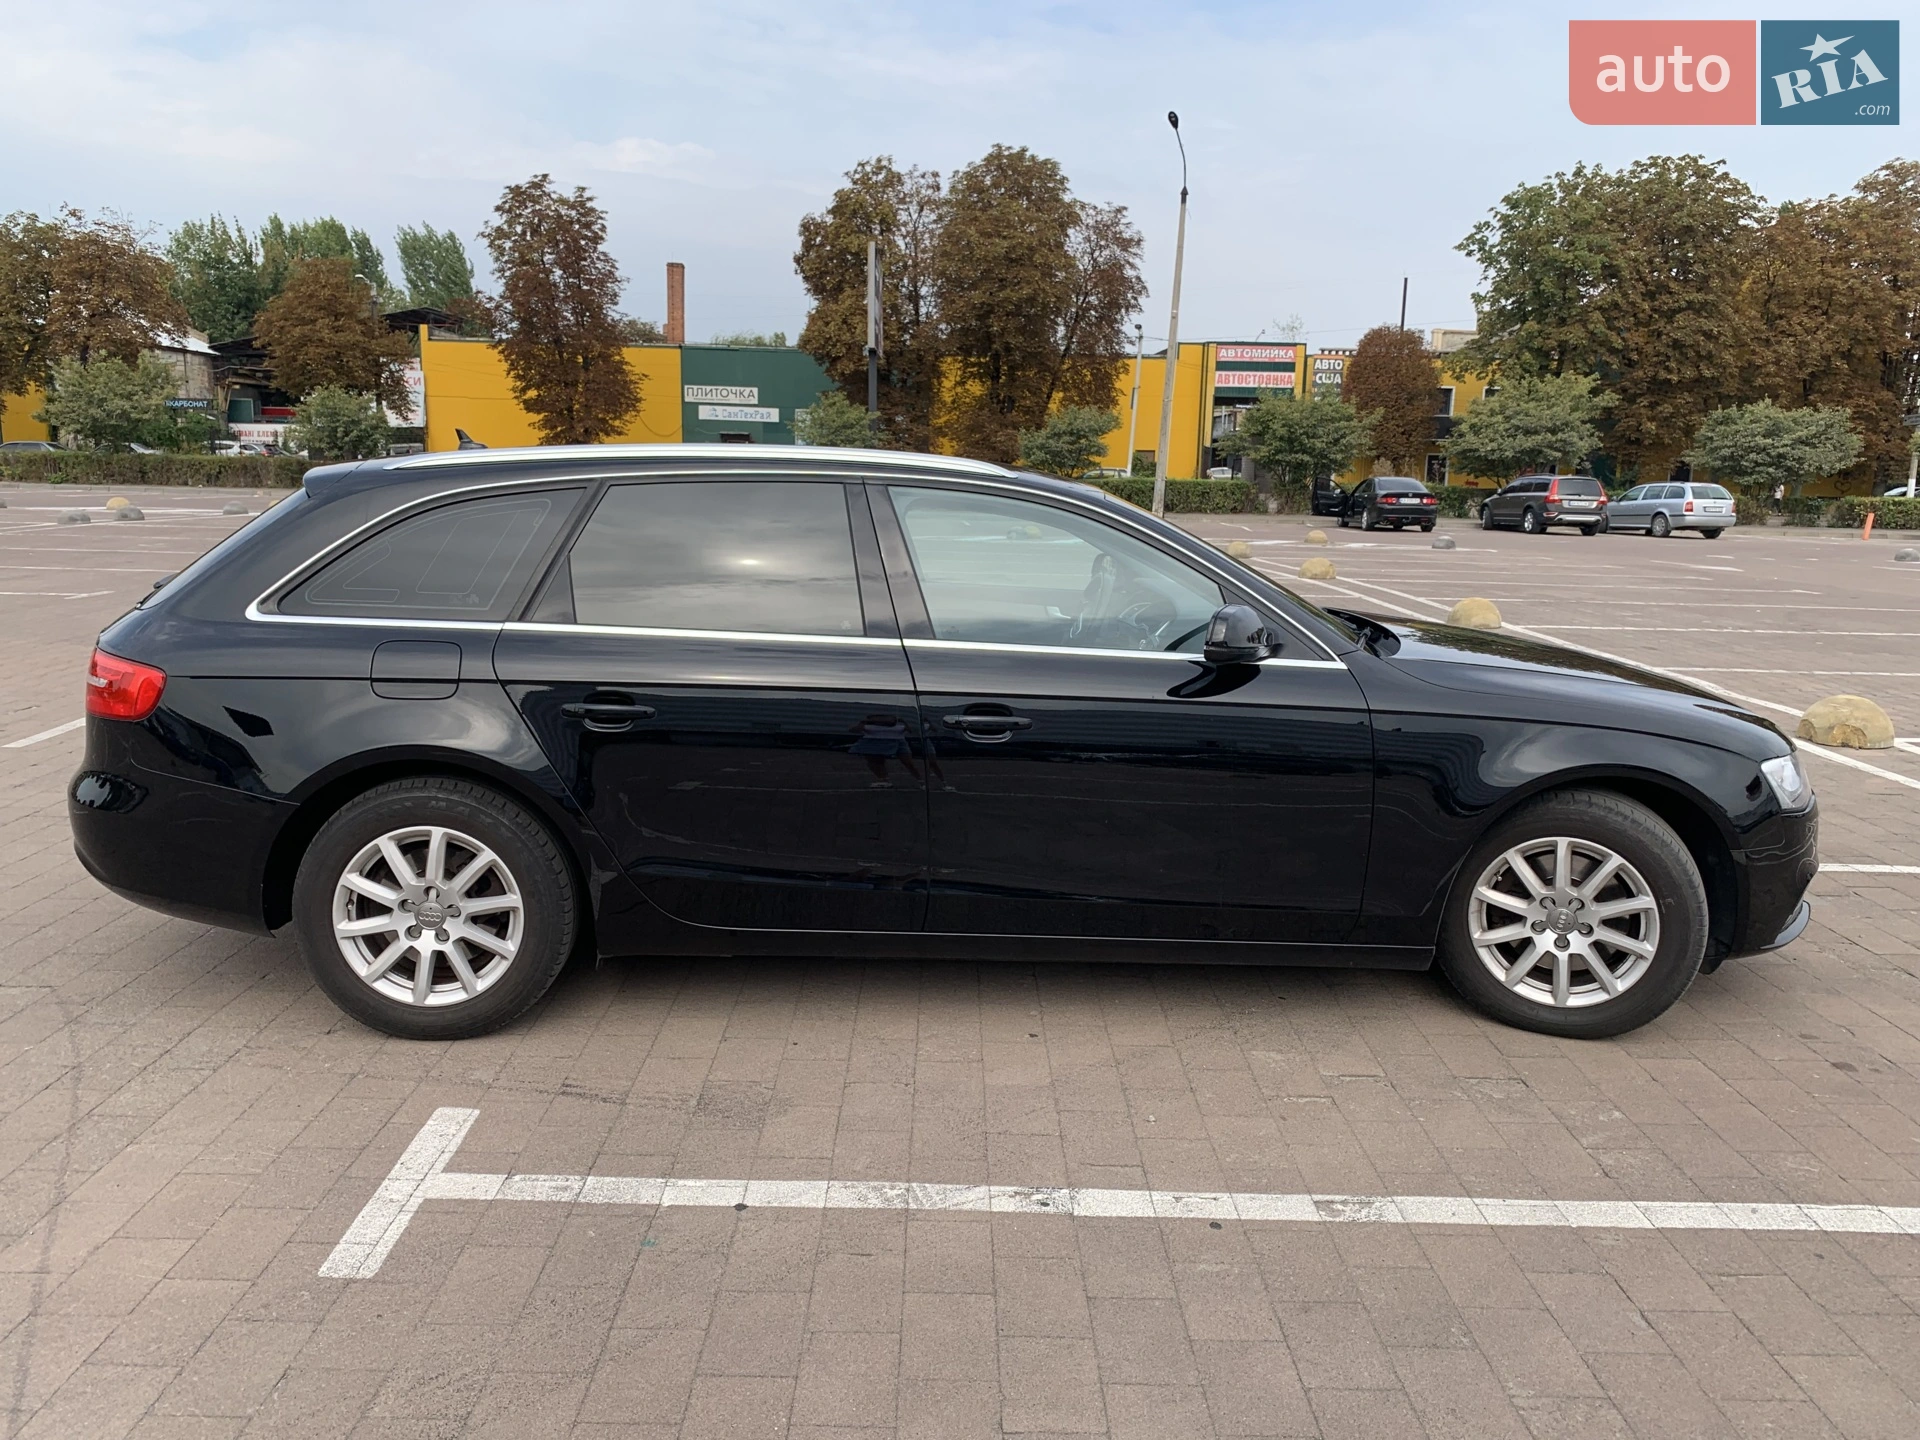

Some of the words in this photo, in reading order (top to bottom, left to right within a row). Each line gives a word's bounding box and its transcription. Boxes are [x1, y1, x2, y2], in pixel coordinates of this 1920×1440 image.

[1219, 347, 1294, 358] АВТОМИЙКА
[1314, 359, 1343, 370] АВТО
[1216, 373, 1293, 386] АВТОСТОЯНКА
[1315, 372, 1342, 384] США
[686, 387, 756, 399] ПЛИТОЧКА
[722, 408, 772, 420] СанТехРай
